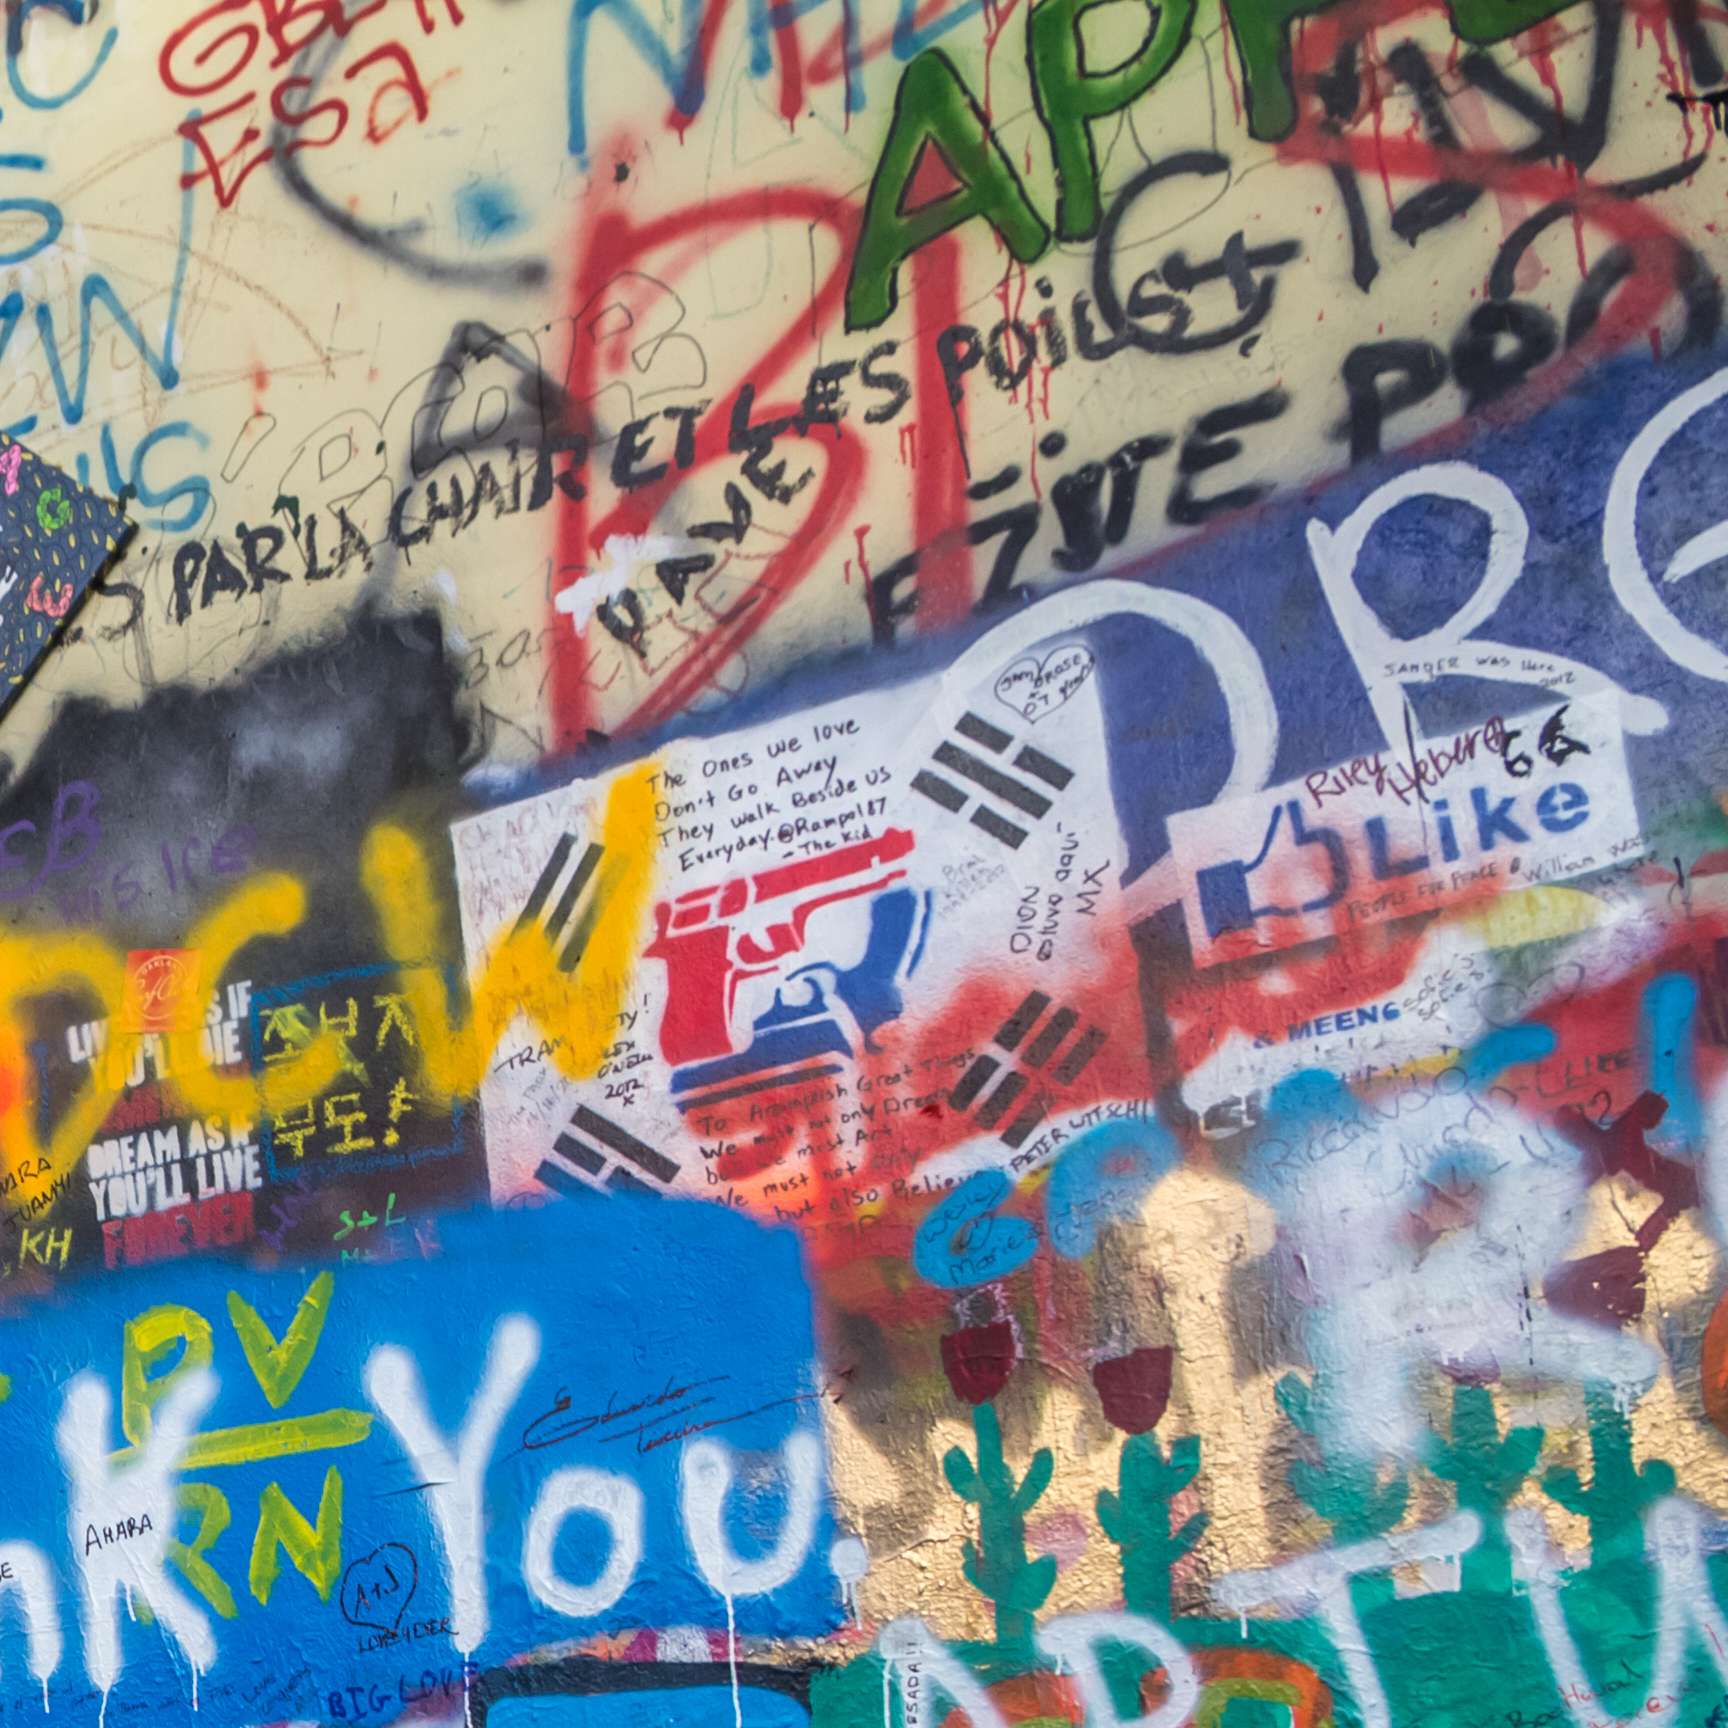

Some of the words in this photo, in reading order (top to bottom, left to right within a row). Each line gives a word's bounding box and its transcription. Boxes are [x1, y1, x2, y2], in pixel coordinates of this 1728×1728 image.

[646, 770, 687, 795] The
[702, 752, 754, 778] Ones
[767, 736, 803, 758] we
[813, 718, 861, 742] love
[654, 791, 716, 822] Don't
[728, 783, 759, 802] Go
[776, 756, 837, 790] Away
[657, 822, 714, 848] They
[730, 801, 781, 829] walk
[791, 777, 858, 809] Beside
[797, 840, 836, 855] The
[697, 1116, 726, 1136] To
[856, 1064, 914, 1093] Great
[86, 1125, 181, 1181] DREAM
[700, 1141, 738, 1160] We
[88, 1162, 191, 1223] YOU'LL
[195, 1142, 263, 1200] LIVE
[763, 1173, 810, 1198] must
[83, 1513, 155, 1556] AMARA
